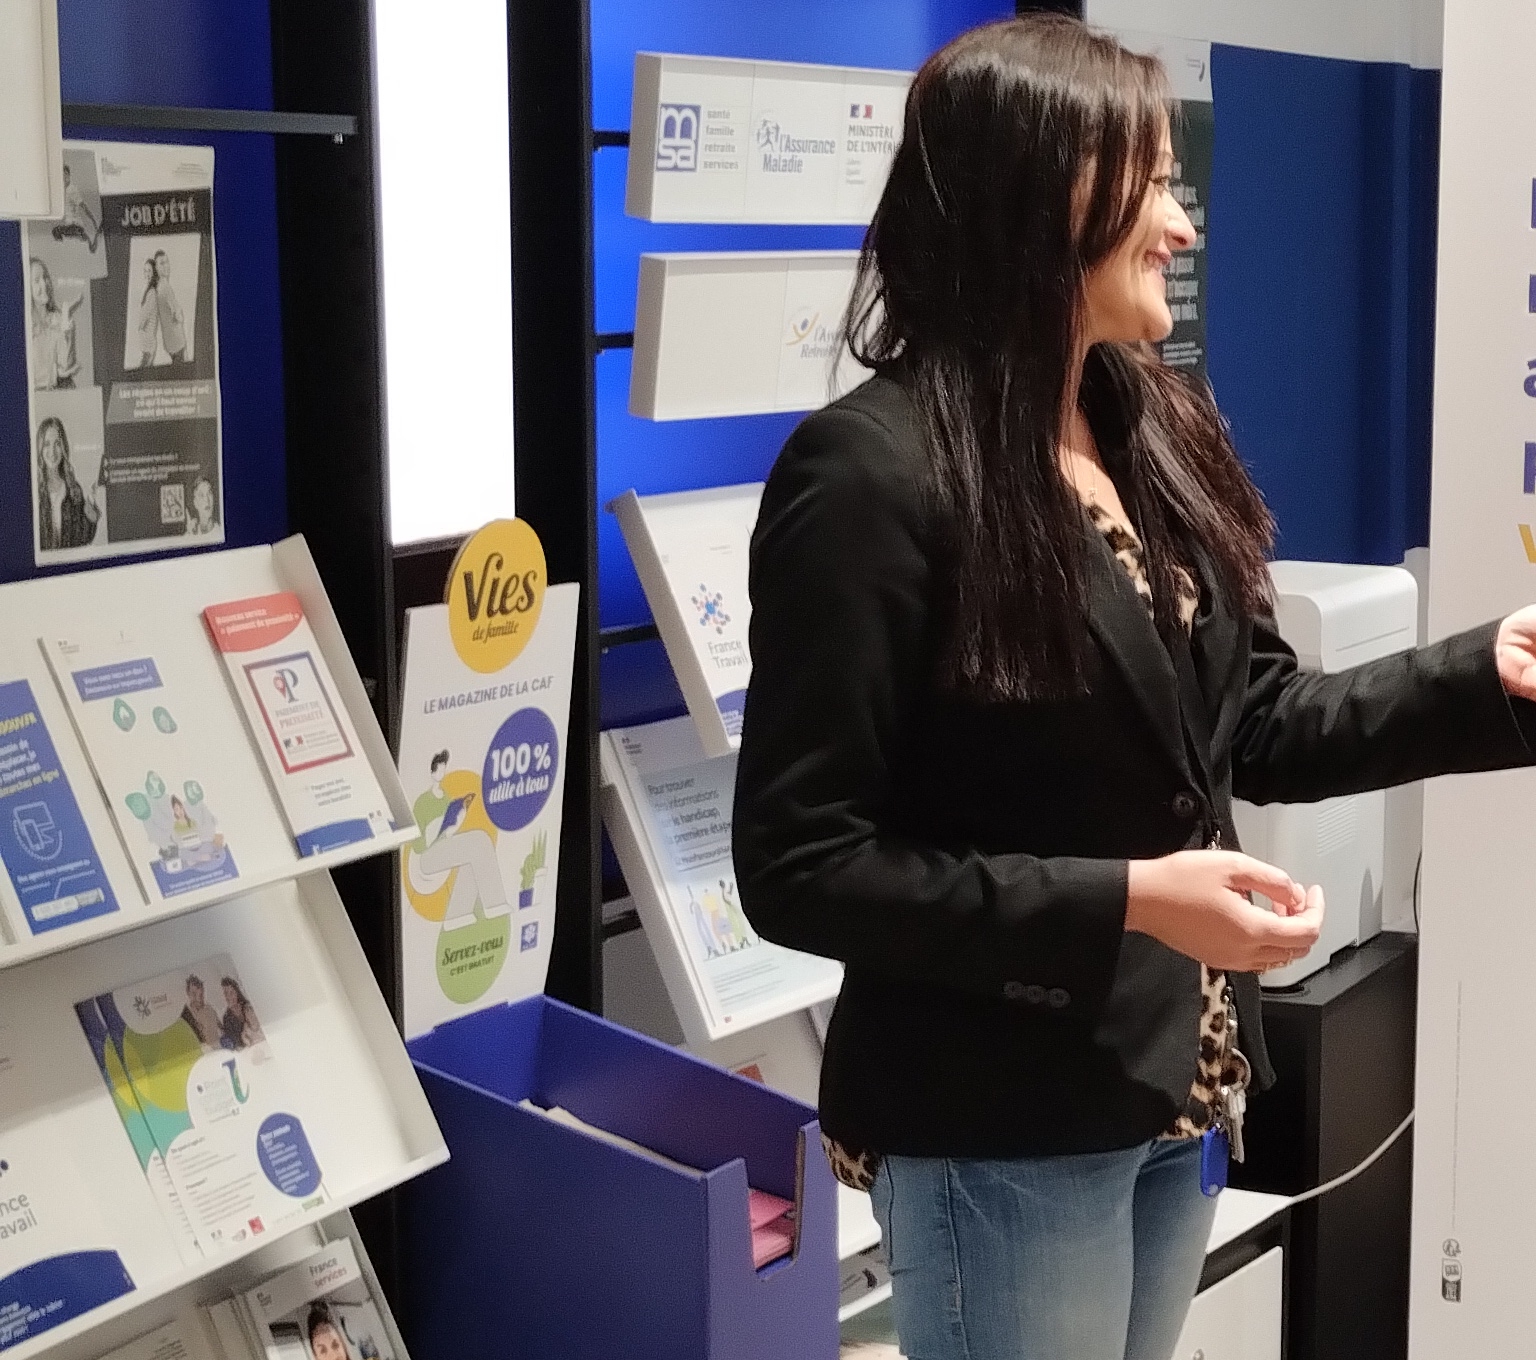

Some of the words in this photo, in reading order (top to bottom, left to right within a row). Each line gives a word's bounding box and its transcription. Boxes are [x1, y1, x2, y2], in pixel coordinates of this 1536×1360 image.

[707, 109, 731, 120] santé
[705, 125, 735, 137] famille
[780, 134, 836, 156] l'Assurance
[703, 159, 739, 171] services
[762, 153, 804, 174] Maladie
[463, 552, 538, 622] Vies
[472, 626, 483, 641] de
[484, 620, 520, 644] famille
[708, 639, 743, 657] France
[712, 648, 749, 669] Travail
[424, 700, 437, 715] LE
[438, 687, 498, 711] MAGAZINE
[500, 683, 514, 698] DE
[516, 681, 529, 696] LA
[532, 676, 554, 692] CAF
[491, 743, 530, 782] 100
[533, 742, 551, 770] %
[516, 776, 525, 800] à
[525, 772, 549, 795] tous
[0, 1193, 30, 1217] nce
[1, 1209, 38, 1240] avail
[309, 1257, 338, 1277] France
